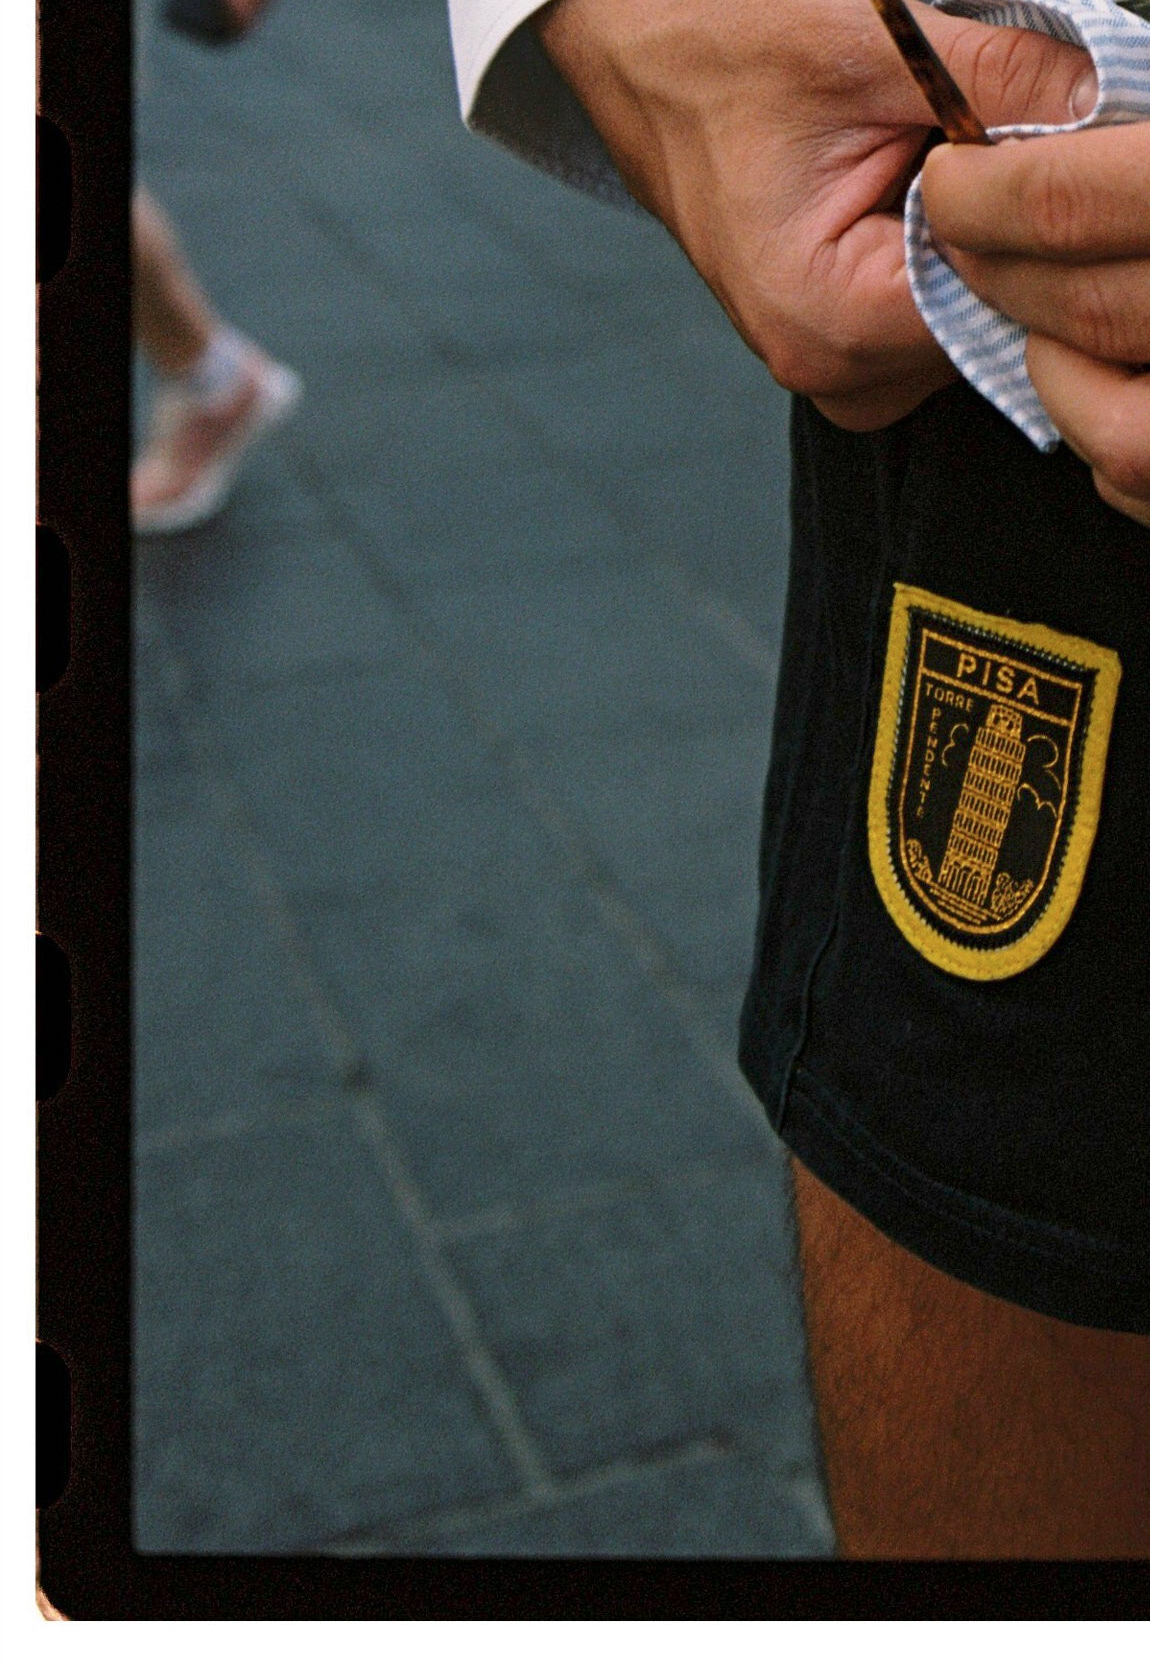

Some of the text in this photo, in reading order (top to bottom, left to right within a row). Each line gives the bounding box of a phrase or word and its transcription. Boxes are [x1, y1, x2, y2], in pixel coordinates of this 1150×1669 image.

[925, 682, 975, 712] TORRE
[956, 652, 1040, 705] PISA
[916, 707, 942, 819] PENDENTE
